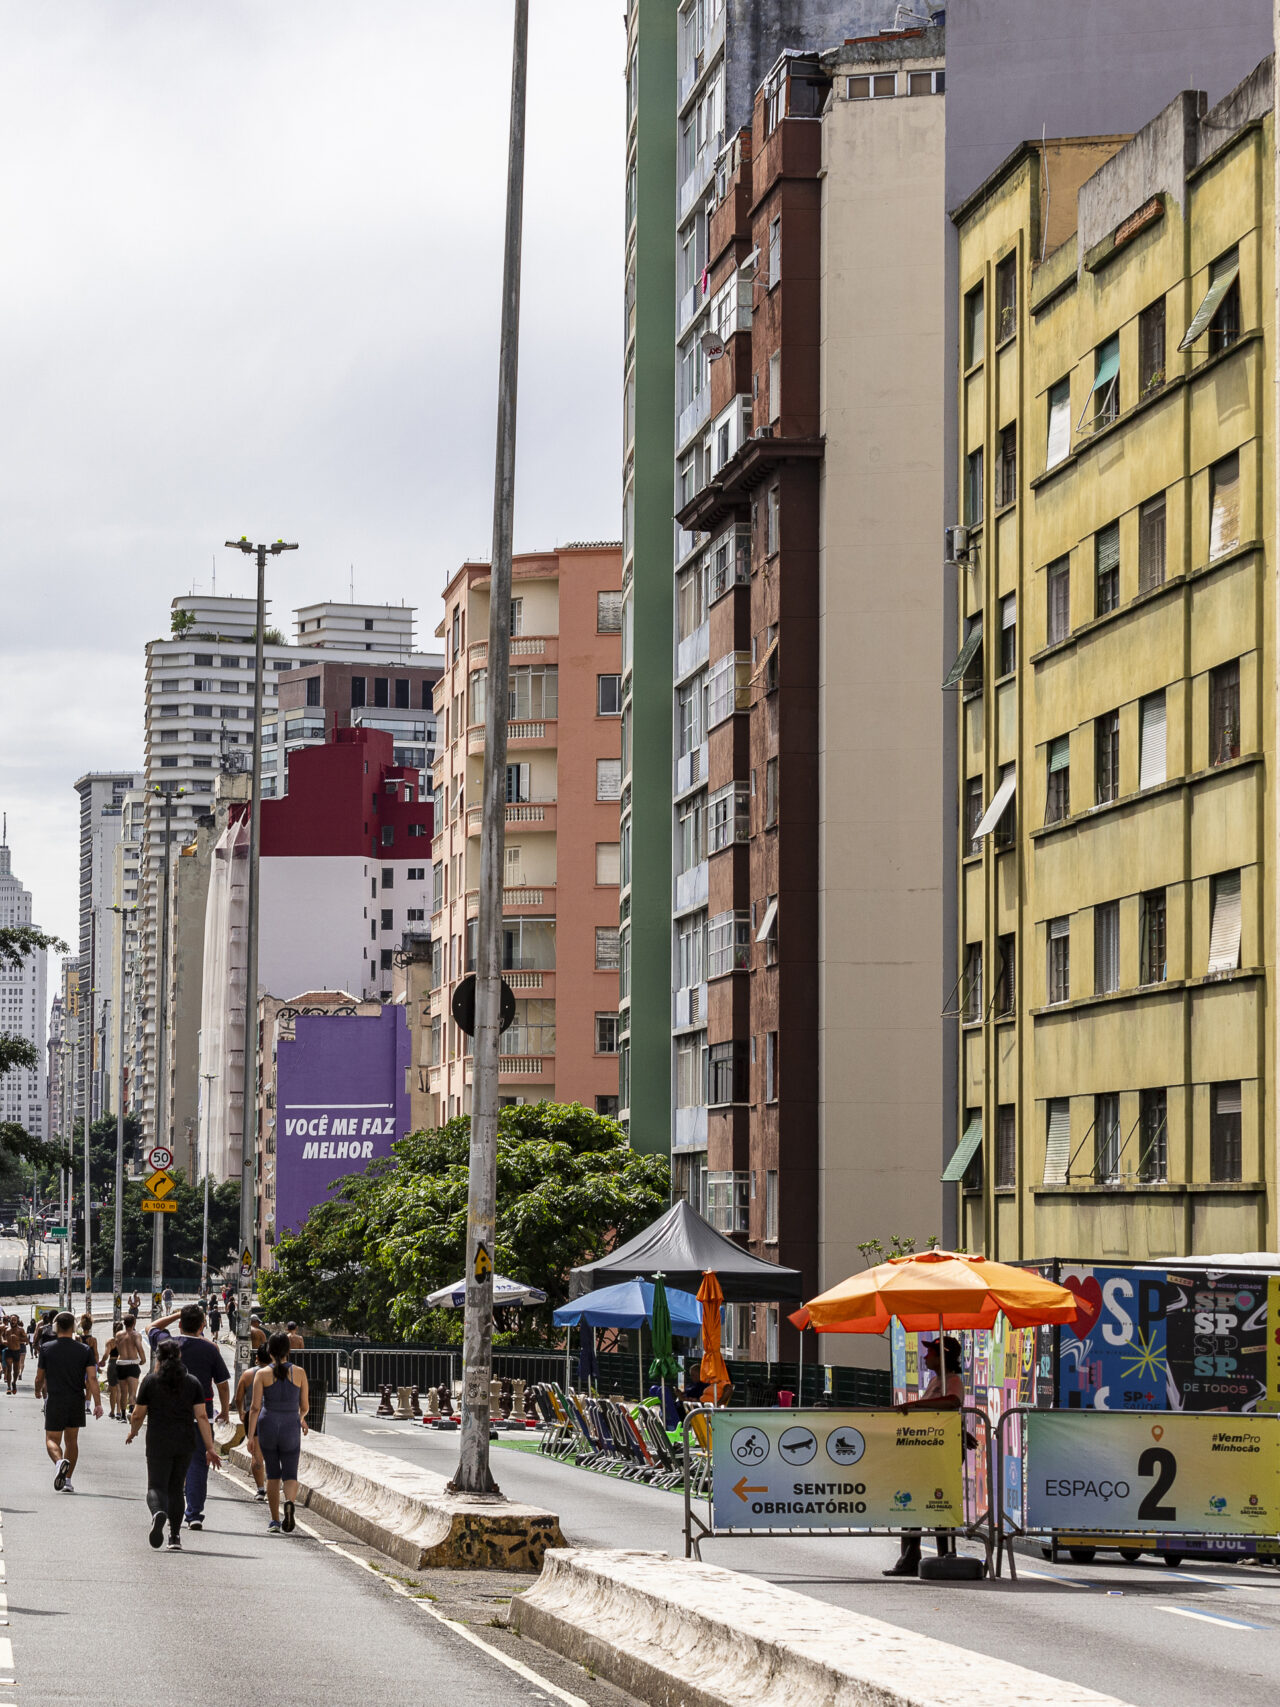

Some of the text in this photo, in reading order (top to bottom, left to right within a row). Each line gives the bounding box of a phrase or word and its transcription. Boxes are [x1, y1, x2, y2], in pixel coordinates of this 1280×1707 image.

[285, 1114, 396, 1136] VOCÊ ME FAZ
[153, 1152, 169, 1163] 50
[302, 1141, 374, 1159] MELHOR
[1194, 1291, 1236, 1311] SP
[1194, 1312, 1238, 1335] SP
[1194, 1334, 1238, 1357] SP
[1194, 1356, 1237, 1377] SP
[1183, 1383, 1248, 1394] DE TODOS
[896, 1427, 945, 1436] #VemPro
[1212, 1433, 1261, 1443] #VemPro
[896, 1438, 945, 1446] Minhocão
[1212, 1444, 1260, 1453] Minhocão
[793, 1483, 866, 1495] SENTIDO
[1045, 1479, 1130, 1502] ESPAÇO
[1137, 1447, 1177, 1521] 2
[751, 1498, 867, 1514] OBRIGATÓRIO
